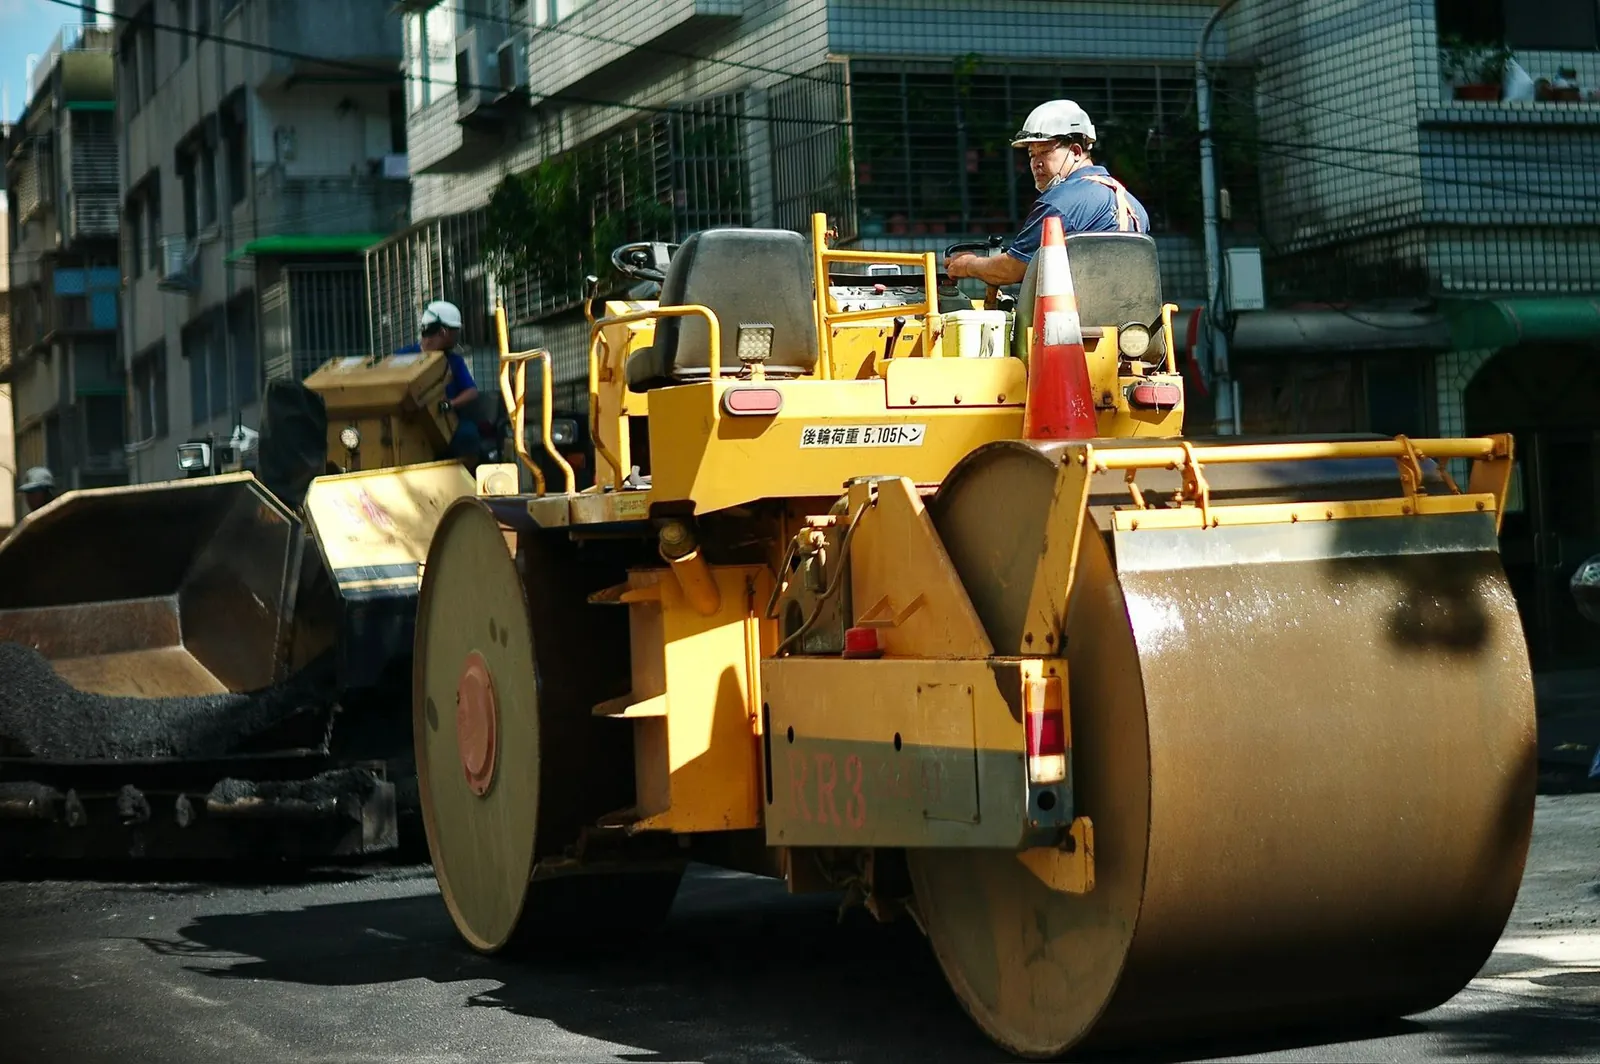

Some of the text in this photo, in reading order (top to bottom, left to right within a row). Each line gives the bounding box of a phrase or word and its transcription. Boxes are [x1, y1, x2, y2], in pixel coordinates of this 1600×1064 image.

[803, 427, 921, 445] 後輪荷重 5.105トン
[786, 749, 867, 830] RR3
